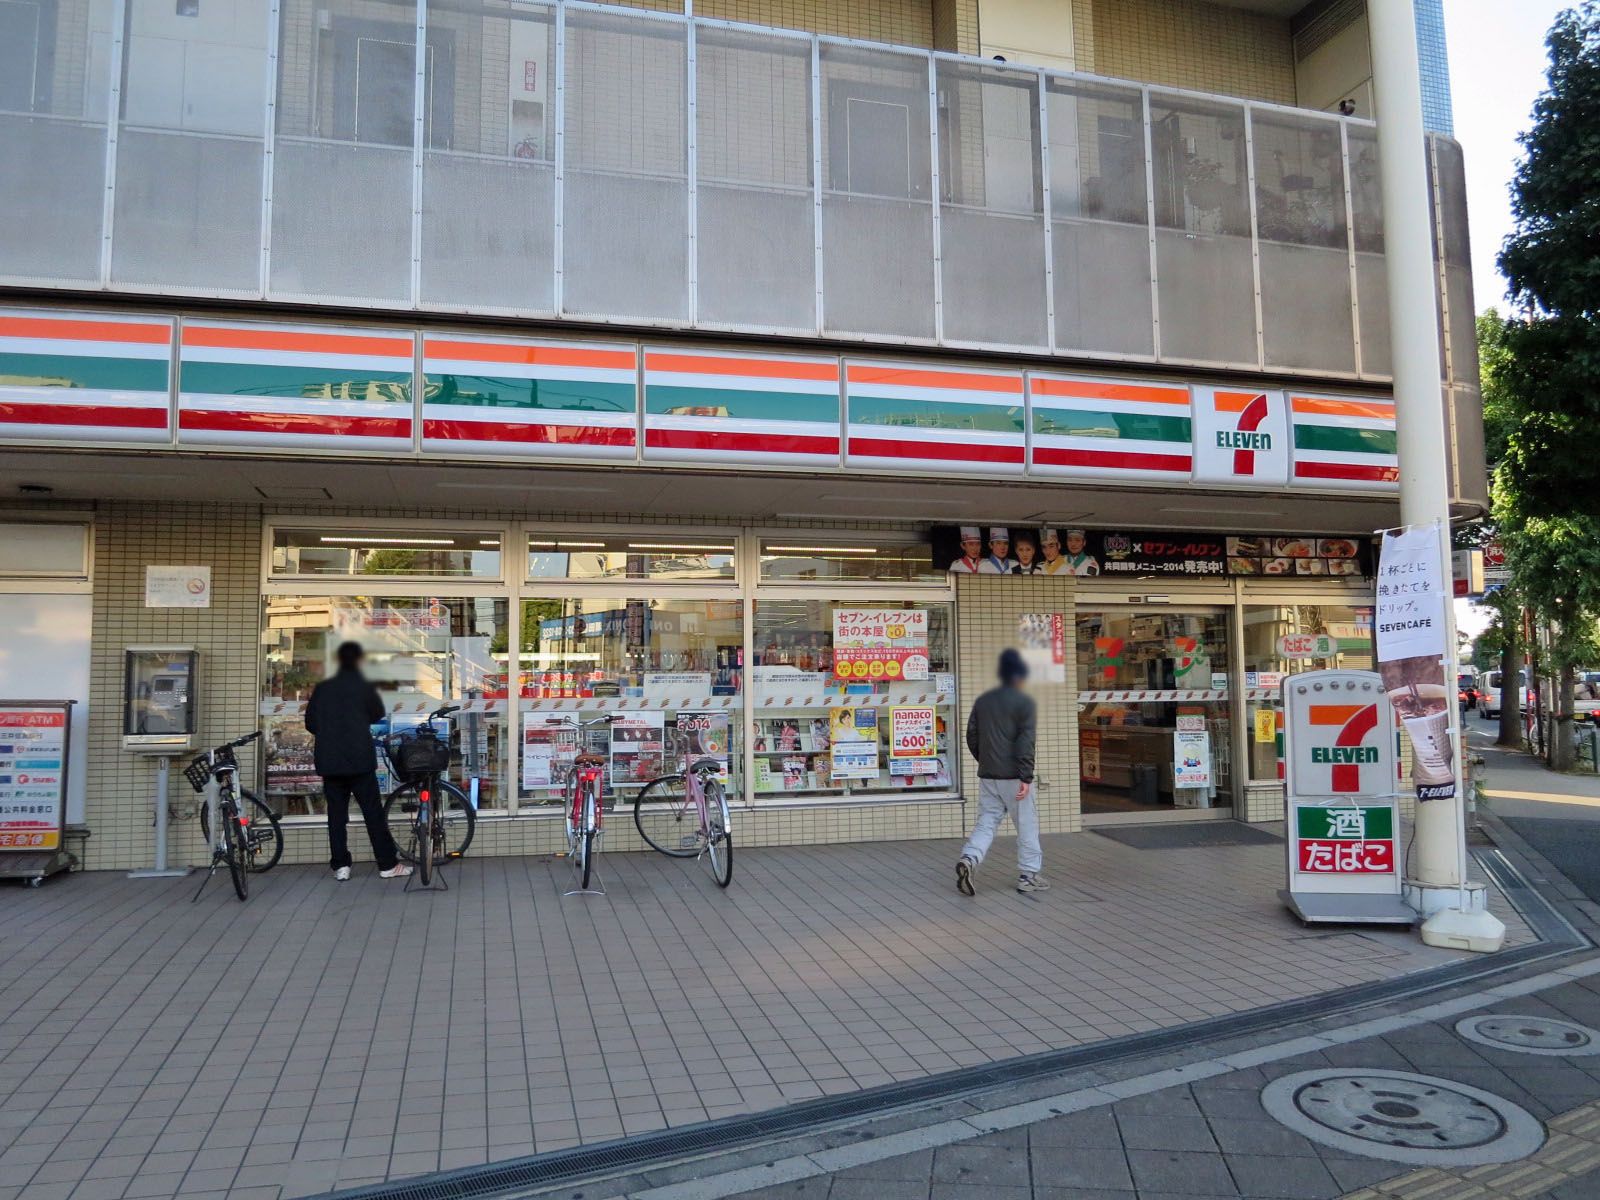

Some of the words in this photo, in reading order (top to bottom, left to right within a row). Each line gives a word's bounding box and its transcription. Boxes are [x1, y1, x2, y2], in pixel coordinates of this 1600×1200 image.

[1216, 431, 1272, 450] ELEVEN
[1379, 580, 1431, 597] 挽きたてを
[838, 625, 884, 637] 街の本屋
[1283, 637, 1313, 653] たばこ
[1317, 637, 1330, 652] 酒
[28, 715, 53, 725] ATM
[895, 711, 931, 719] nanaco
[677, 718, 712, 731] 2014
[901, 735, 926, 747] 600
[1311, 747, 1379, 763] ELEVEN
[1326, 808, 1367, 838] 酒
[1306, 842, 1388, 872] たばこ
